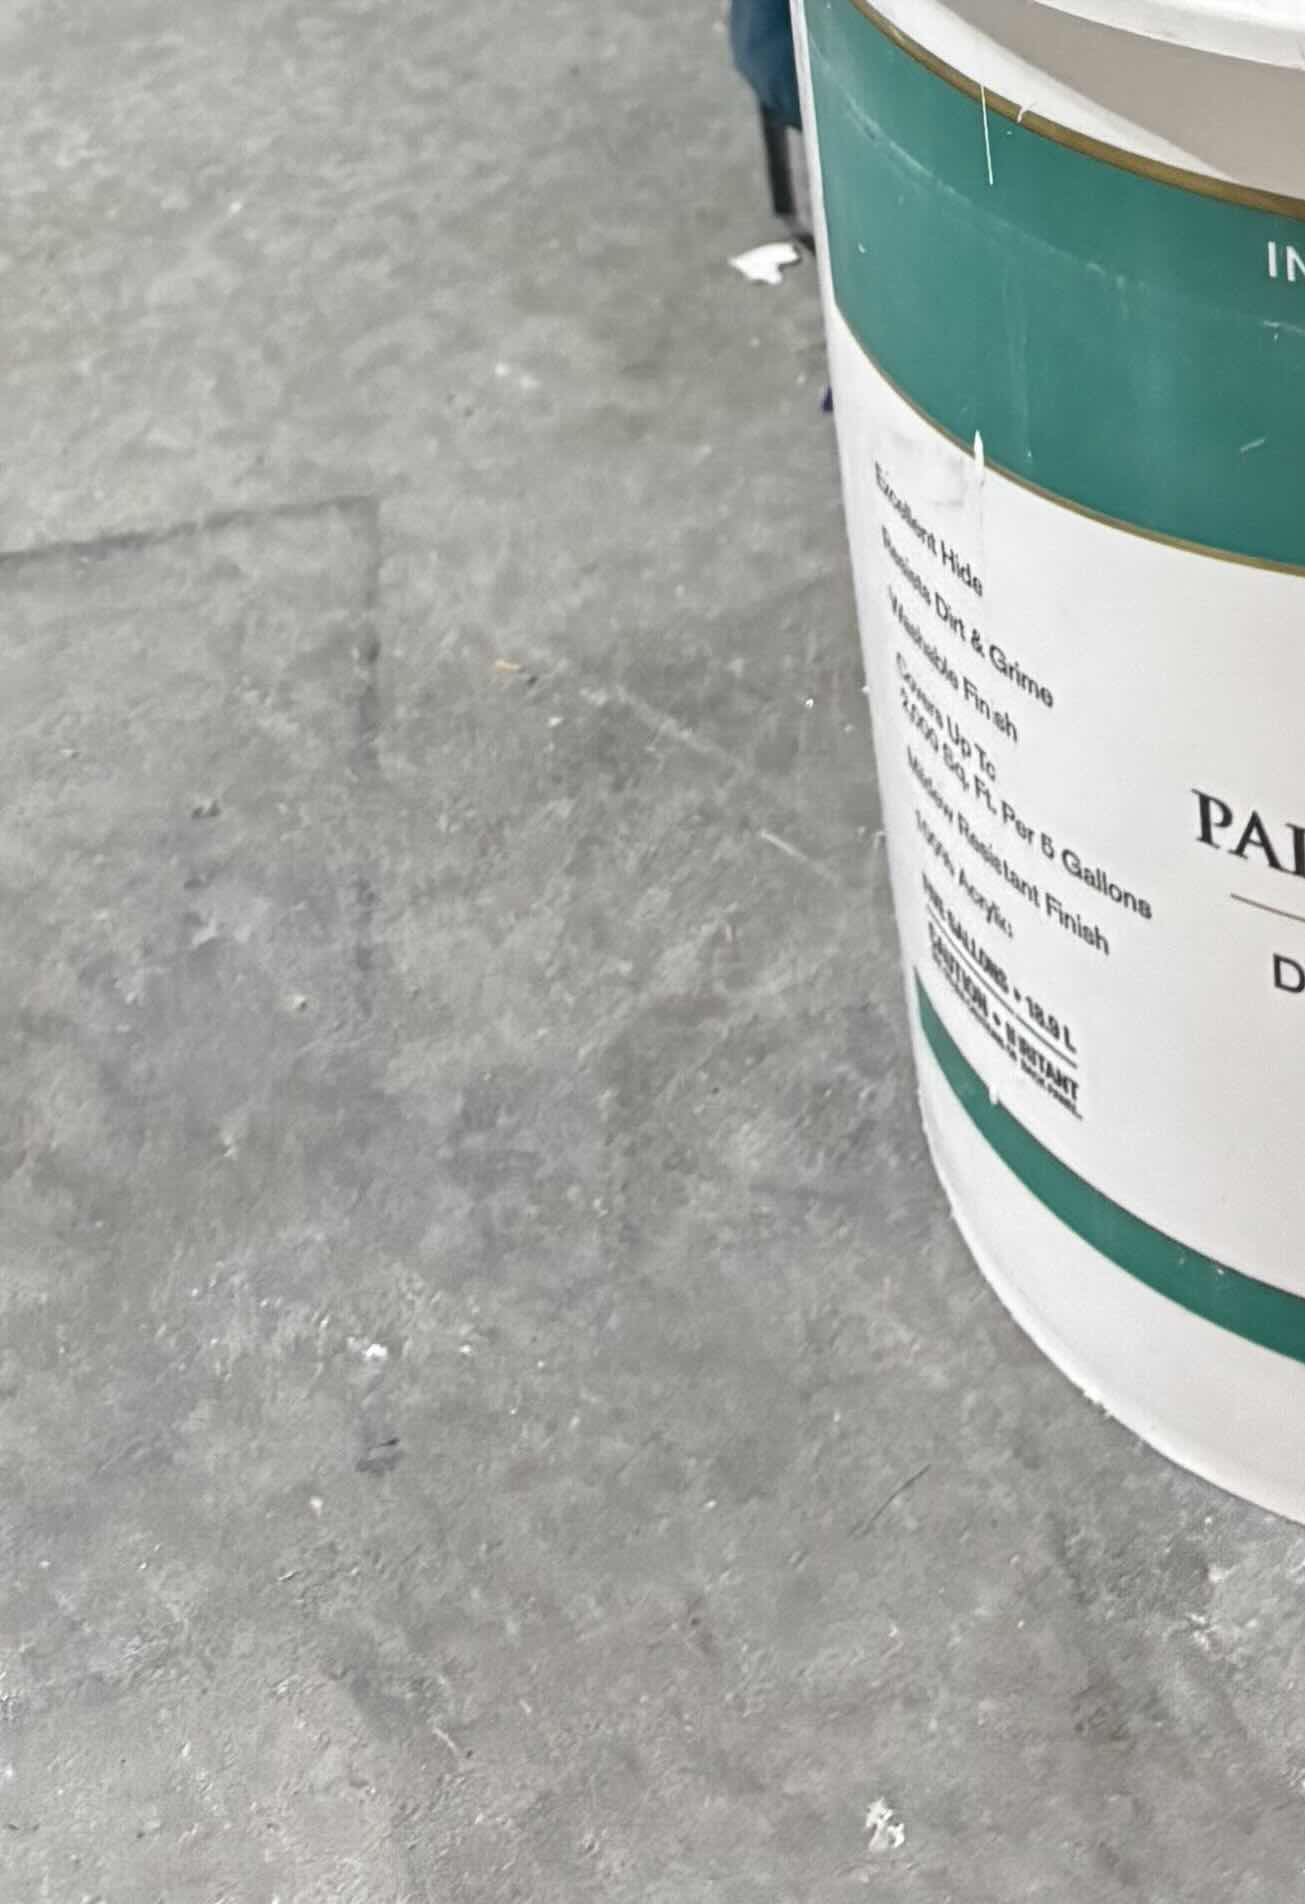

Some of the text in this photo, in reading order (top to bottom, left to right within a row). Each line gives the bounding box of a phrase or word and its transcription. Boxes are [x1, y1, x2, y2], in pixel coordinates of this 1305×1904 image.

[940, 540, 983, 597] Hide
[935, 592, 965, 642] Dirt
[971, 629, 985, 658] &
[990, 644, 1053, 708] Grime
[963, 676, 1018, 743] Finish
[948, 715, 971, 758] Up
[975, 743, 996, 782] To
[957, 812, 1040, 908] Resistant
[1045, 892, 1109, 956] Finish
[1001, 799, 1035, 845] Per
[1040, 832, 1055, 860] 5
[1062, 849, 1153, 920] Gallons
[1063, 1024, 1077, 1053] L
